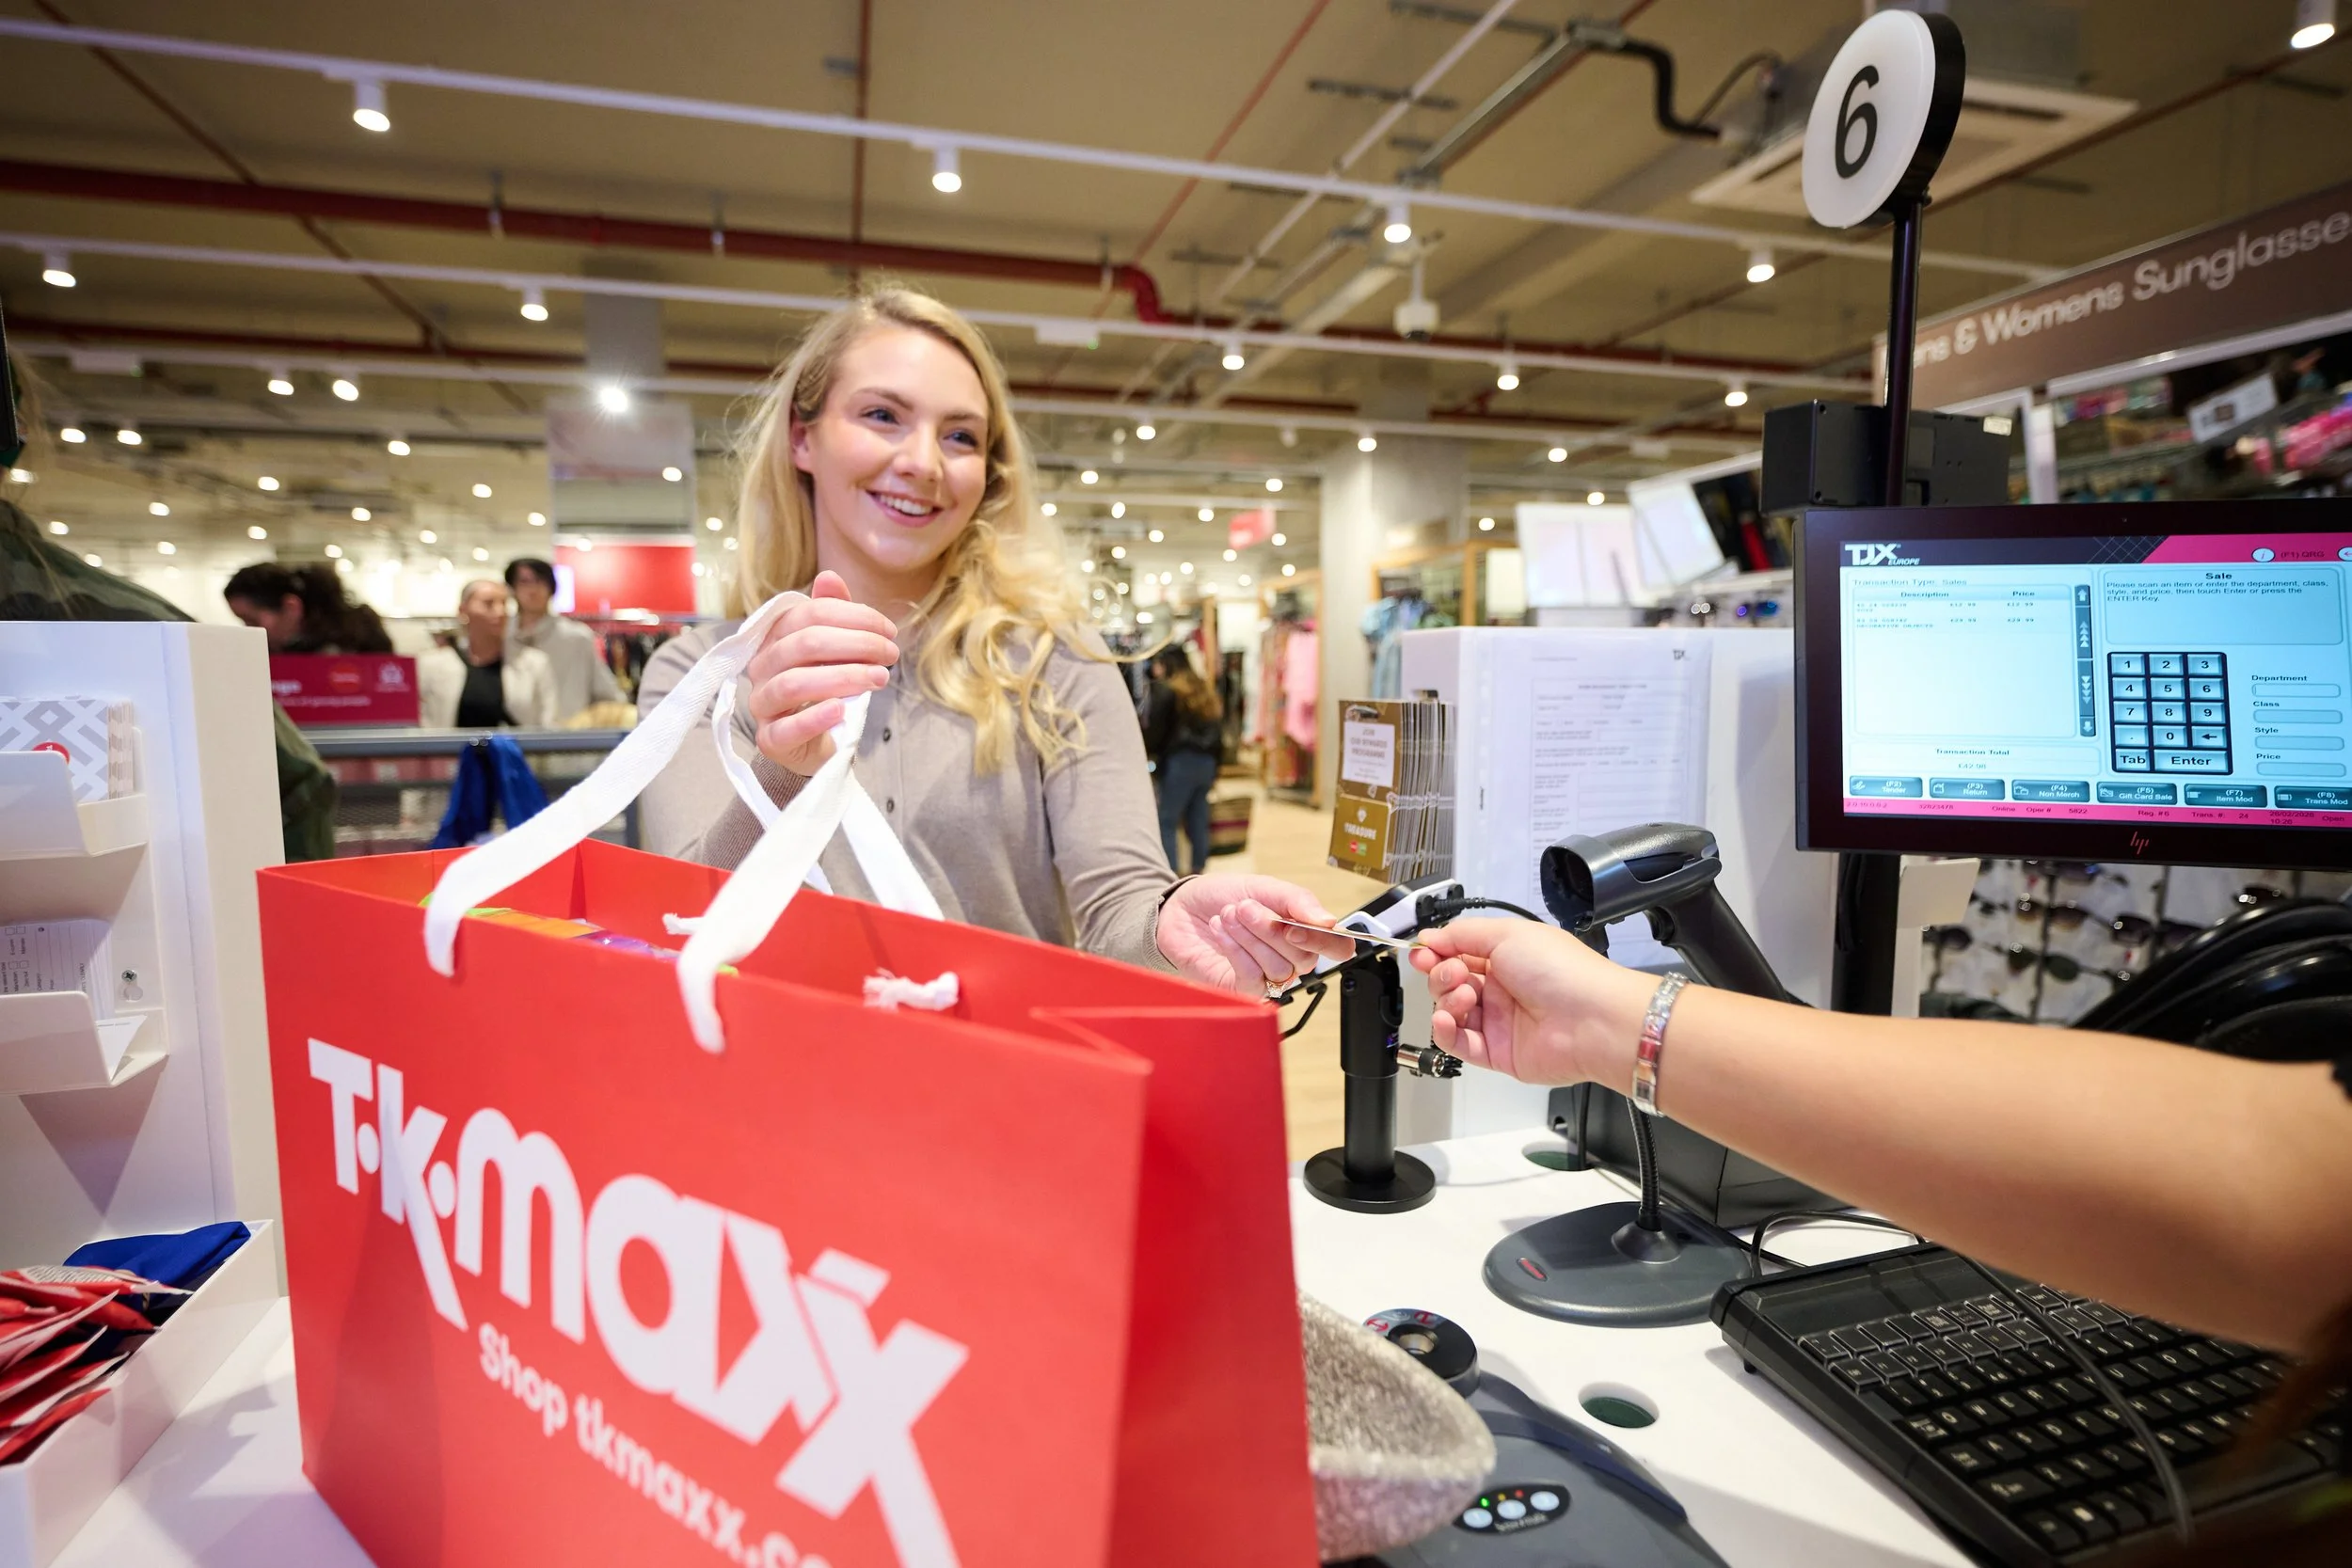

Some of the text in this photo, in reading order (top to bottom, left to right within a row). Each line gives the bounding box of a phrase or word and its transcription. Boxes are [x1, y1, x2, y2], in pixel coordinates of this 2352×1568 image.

[1835, 65, 1880, 179] 6
[1914, 211, 2352, 370] ens & Womens Sunglasse
[1845, 543, 1899, 566] TJX
[1888, 558, 1920, 566] EUROPE
[1900, 591, 1949, 599] Description
[2124, 660, 2209, 669] 1 2 3
[2251, 674, 2308, 683] Department
[2125, 684, 2133, 692] 4
[2164, 684, 2171, 692] 5
[2126, 707, 2212, 717] 7 8 9
[2166, 732, 2174, 740] 0
[2120, 755, 2146, 765] Tab
[2170, 755, 2212, 766] Enter
[2057, 790, 2079, 799] Merch
[479, 1323, 834, 1568] Shop tkmaxx.c
